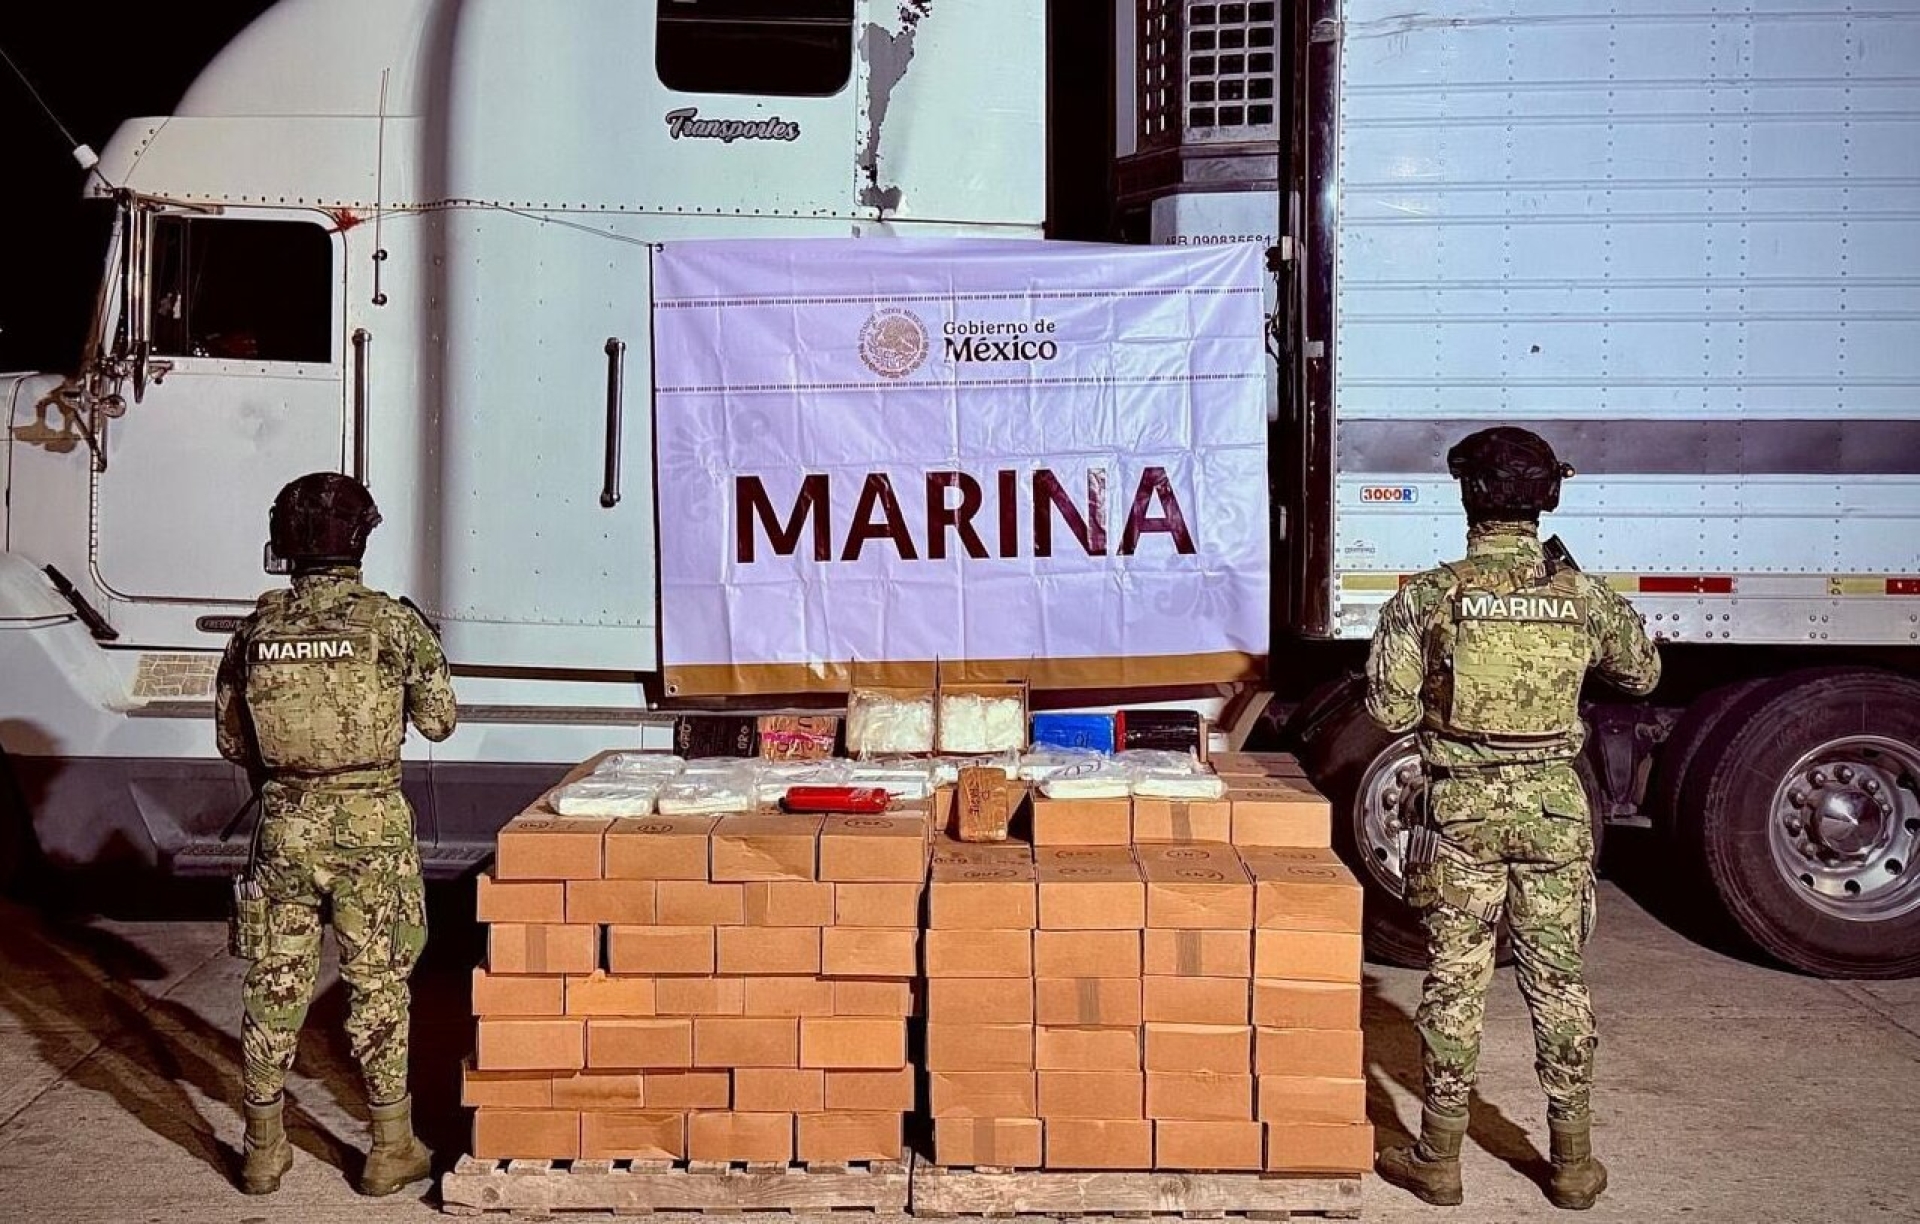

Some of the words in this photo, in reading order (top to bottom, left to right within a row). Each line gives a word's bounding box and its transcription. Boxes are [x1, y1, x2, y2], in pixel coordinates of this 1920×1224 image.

[665, 107, 801, 143] Transportes
[943, 321, 1028, 335] Gobierno
[1035, 318, 1056, 333] de
[943, 335, 1058, 363] México
[1363, 488, 1412, 501] 3000R
[735, 466, 1198, 564] MARINA
[1460, 594, 1579, 620] MARINA
[258, 640, 355, 660] MARINA
